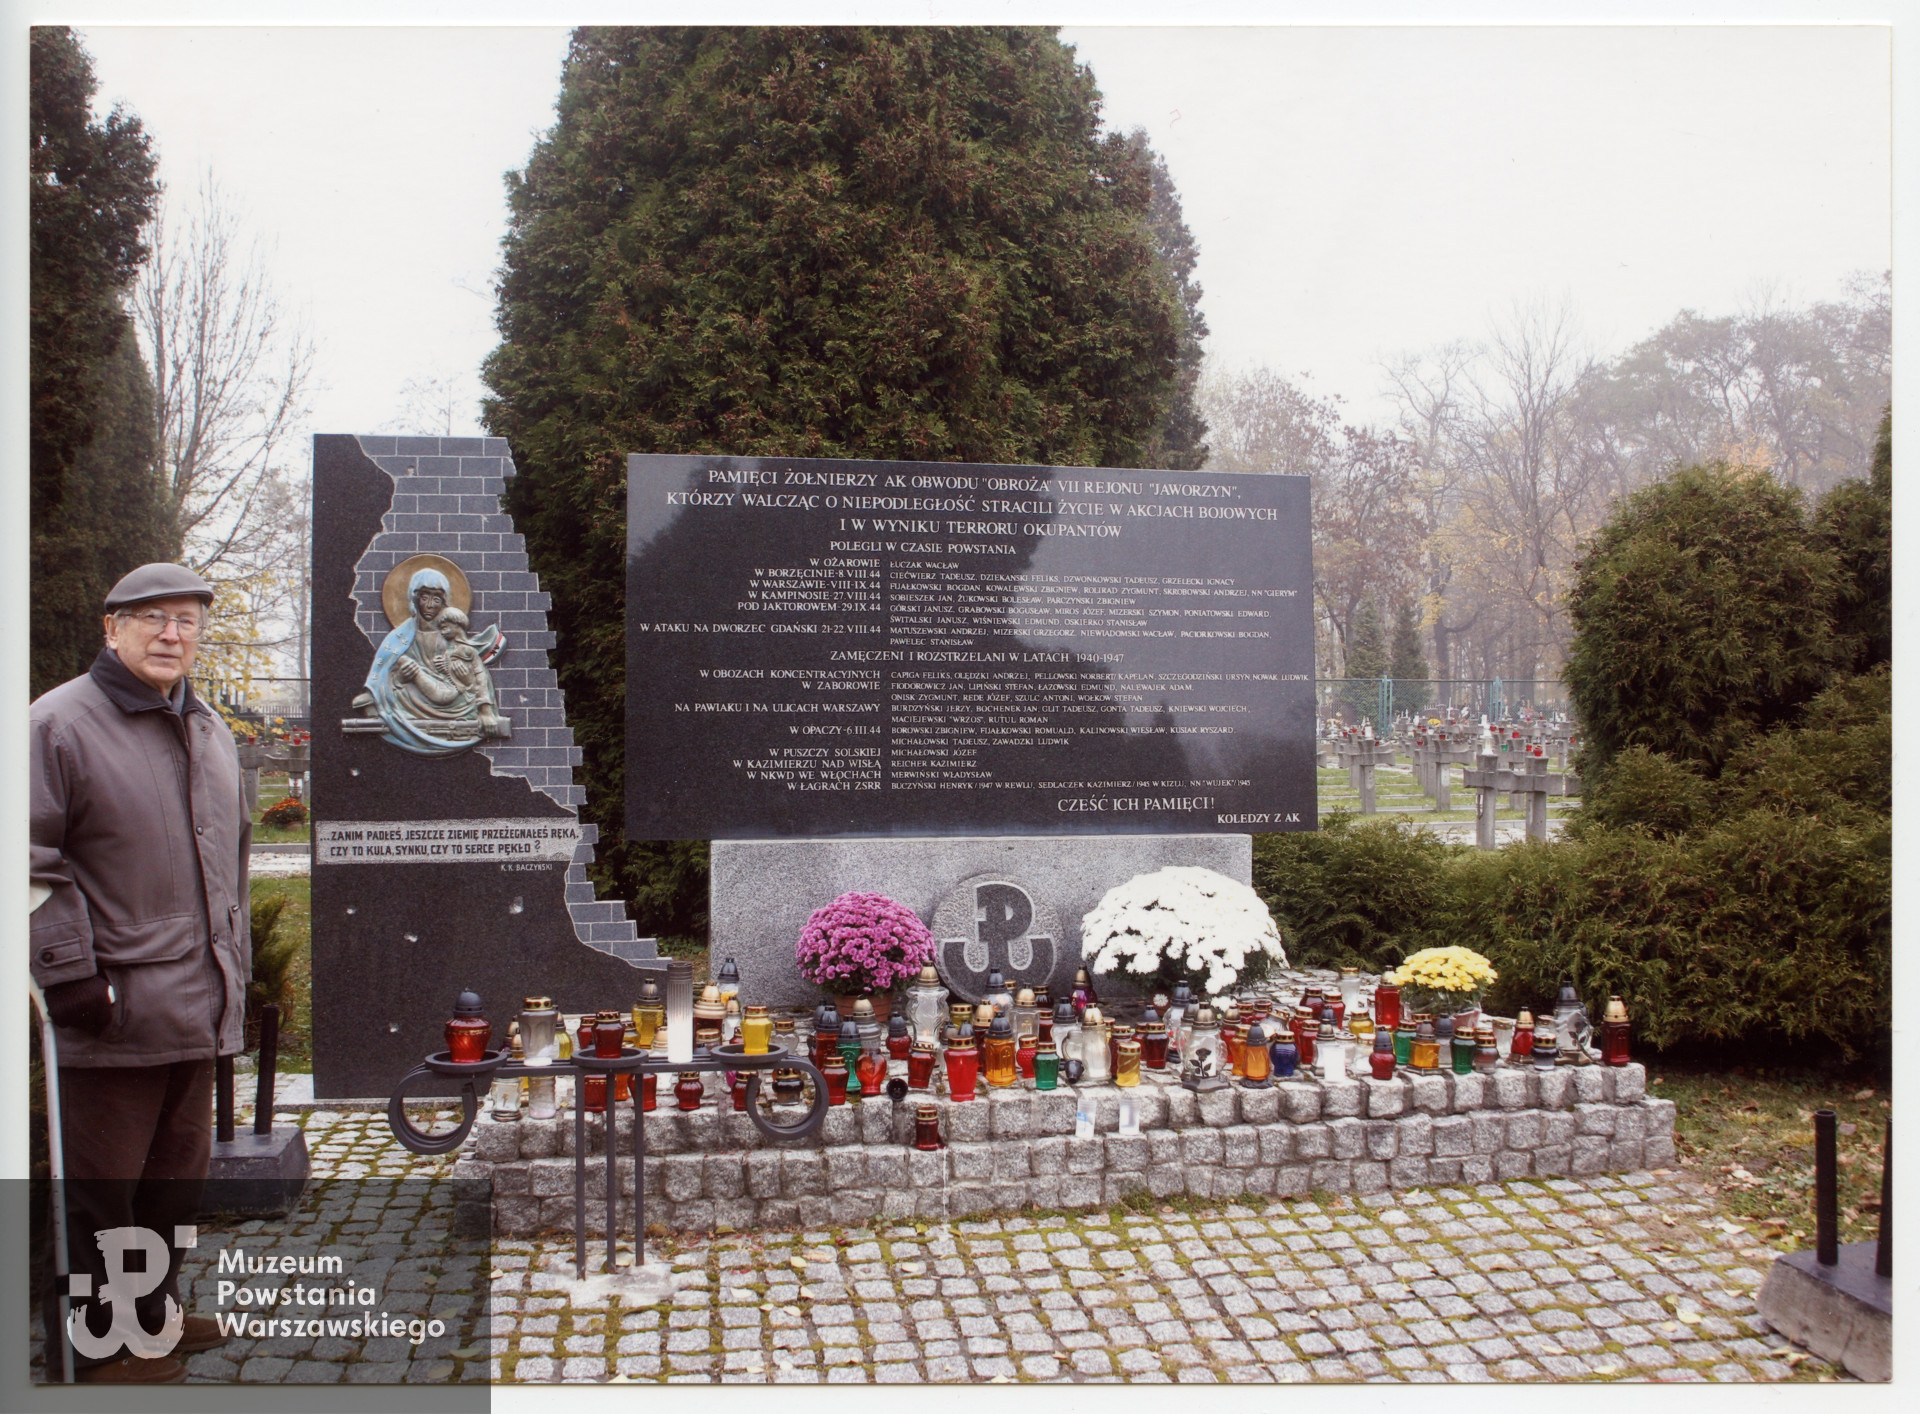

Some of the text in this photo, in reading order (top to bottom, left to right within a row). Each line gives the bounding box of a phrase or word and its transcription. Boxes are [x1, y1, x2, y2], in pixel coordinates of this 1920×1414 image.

[708, 468, 1241, 500] PAMIĘCI ŻOŁNIERZY AK OBWODU "OBROŻA" VII REJONU "JAWORZYN",
[667, 488, 1277, 521] KTÓRZY WALCZĄC O NIEPODLEGŁOŚĆ STRACILI ŻYCIE W AKCJACH BOJOWYCH
[851, 518, 865, 532] W
[872, 519, 939, 534] WYNIKU
[946, 521, 1017, 535] TERRORU
[1023, 519, 1121, 537] OKUPANTÓW
[830, 540, 1016, 555] POLEGLI W CZASIE POWSTANIA
[809, 556, 880, 568] W OŻAROWIE
[754, 569, 764, 578] W
[749, 579, 759, 589] W
[747, 590, 757, 600] W
[737, 601, 759, 611] POD
[640, 623, 649, 633] W
[653, 623, 689, 633] ATAKU
[693, 624, 708, 633] NA
[712, 624, 765, 634] DWORZEC
[770, 622, 817, 634] GDAŃSKI
[830, 650, 903, 663] ZAMĘCZENI
[916, 651, 1004, 662] ROZSTRZELANI
[1008, 652, 1019, 662] W
[1023, 652, 1068, 662] LATACH
[1076, 653, 1124, 663] 1940-1947
[699, 669, 709, 679] W
[712, 669, 763, 679] OBOZACH
[772, 703, 818, 713] ULICACH
[822, 703, 880, 713] WARSZAWY
[789, 725, 799, 735] W
[848, 759, 881, 770] WISŁĄ
[1057, 795, 1214, 812] CZEŚĆ ICH PAMIĘCI!
[1217, 812, 1300, 824] KOLEDZY Z AK
[405, 830, 444, 840] JESZCZE
[447, 829, 478, 842] ZIEMIĘ
[481, 826, 548, 840] PRZEŻEGNAŁEŚ
[550, 828, 579, 841] RĘKĄ.
[330, 846, 348, 856] CZY
[351, 846, 363, 856] TO
[430, 844, 448, 855] CZY
[451, 844, 462, 855] TO
[464, 844, 494, 854] SERCE
